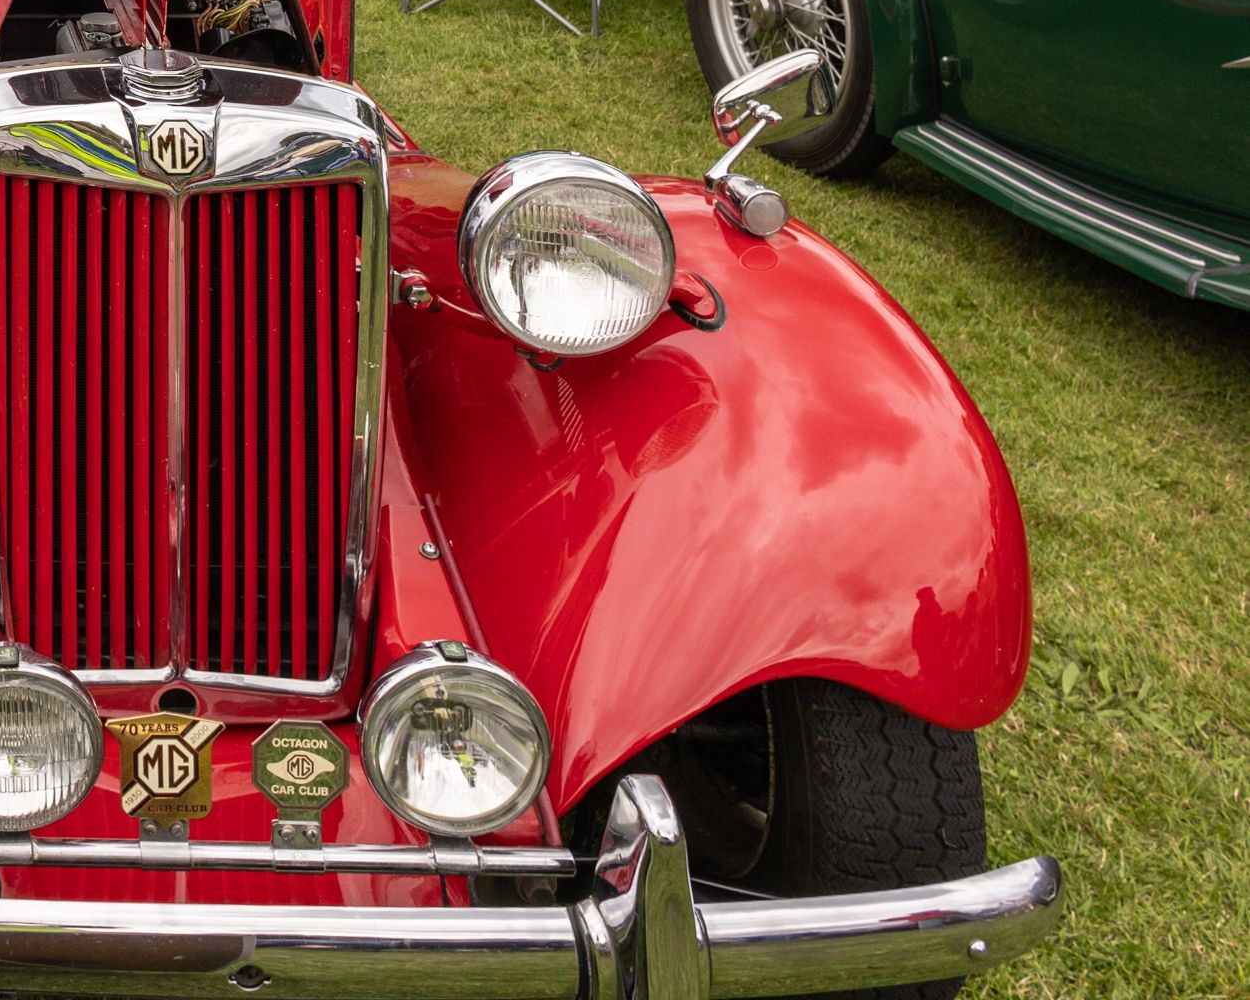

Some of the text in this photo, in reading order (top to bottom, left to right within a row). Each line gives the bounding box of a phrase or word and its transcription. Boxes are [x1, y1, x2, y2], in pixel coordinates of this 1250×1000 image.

[157, 127, 200, 169] MG
[120, 723, 179, 736] 70 YEARS
[190, 724, 210, 745] 2000
[271, 737, 328, 750] OCTAGON
[143, 744, 190, 789] MG
[290, 757, 312, 777] MG
[124, 788, 143, 806] 1930
[270, 784, 329, 797] CAR CLUB
[148, 804, 208, 813] CAR CLUB
